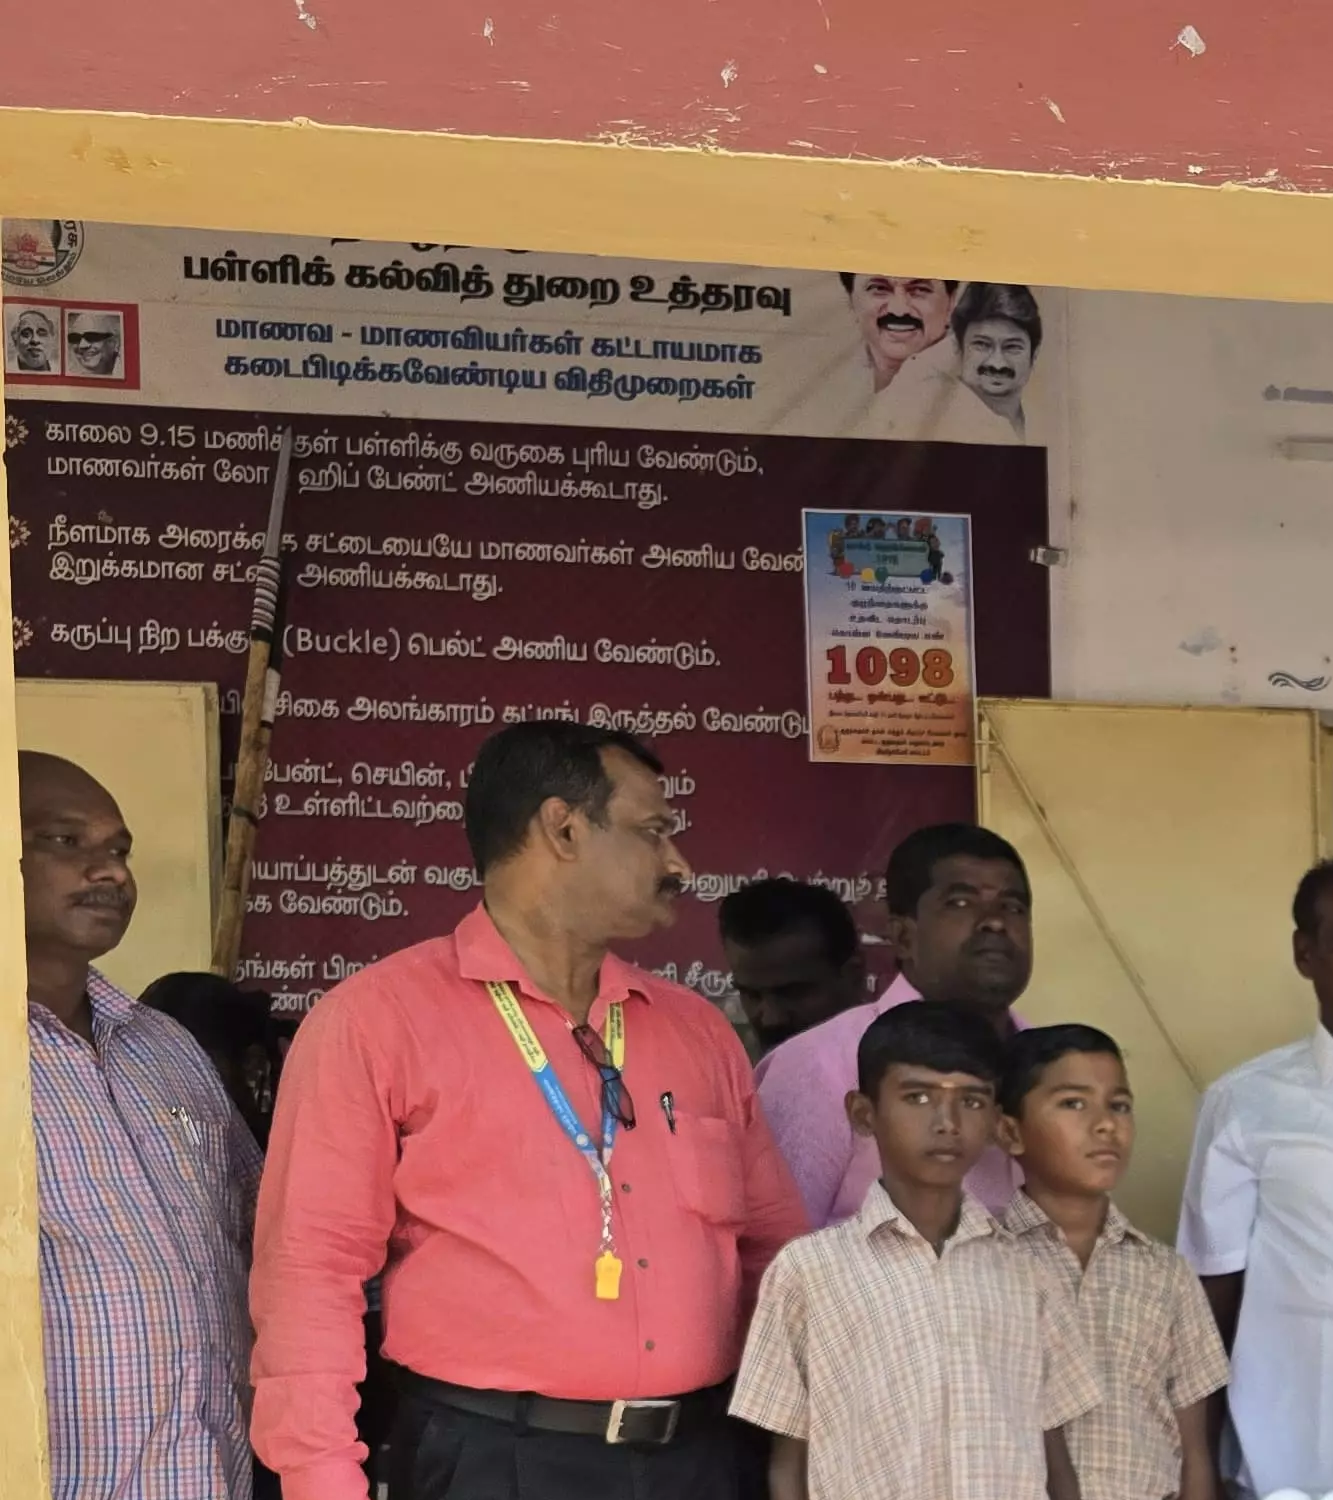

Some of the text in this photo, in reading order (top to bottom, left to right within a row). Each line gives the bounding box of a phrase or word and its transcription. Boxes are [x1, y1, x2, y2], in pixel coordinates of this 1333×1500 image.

[183, 249, 792, 316] பள்ளிக் கல்வித் துறை உத்தரவு
[216, 317, 333, 344] மாணவ
[360, 325, 585, 356] மாணவியர்கள்
[591, 337, 764, 365] கட்டாயமாக
[224, 353, 756, 402] கடைபிடிக்கவேண்டிய விதிமுறைகள்
[46, 422, 132, 444] காலை
[140, 422, 197, 448] 9.15
[345, 432, 464, 464] பள்ளிக்கு
[470, 439, 565, 466] வருகை
[573, 440, 631, 473] புரிய
[47, 453, 206, 482] மாணவர்கள்
[298, 461, 360, 494] ஹிப்
[367, 464, 459, 493] பேண்ட்
[48, 513, 151, 550] நீளமாக
[305, 533, 473, 562] சட்டையையே
[480, 533, 635, 567] மாணவர்கள்
[641, 543, 736, 571] அணிய
[49, 551, 204, 586] இறுக்கமான
[298, 562, 503, 600] அணியக்கூடாது.
[50, 616, 132, 654] கருப்பு
[138, 618, 180, 655] நிற
[282, 624, 401, 661] (Buckle)
[407, 630, 487, 659] பெல்ட்
[492, 634, 588, 662] அணிய
[594, 637, 721, 670] வேண்டும்.
[826, 644, 955, 689] 1098
[347, 694, 496, 727] அலங்காரம்
[588, 702, 697, 737] இருத்தல்
[279, 888, 409, 921] வேண்டும்.
